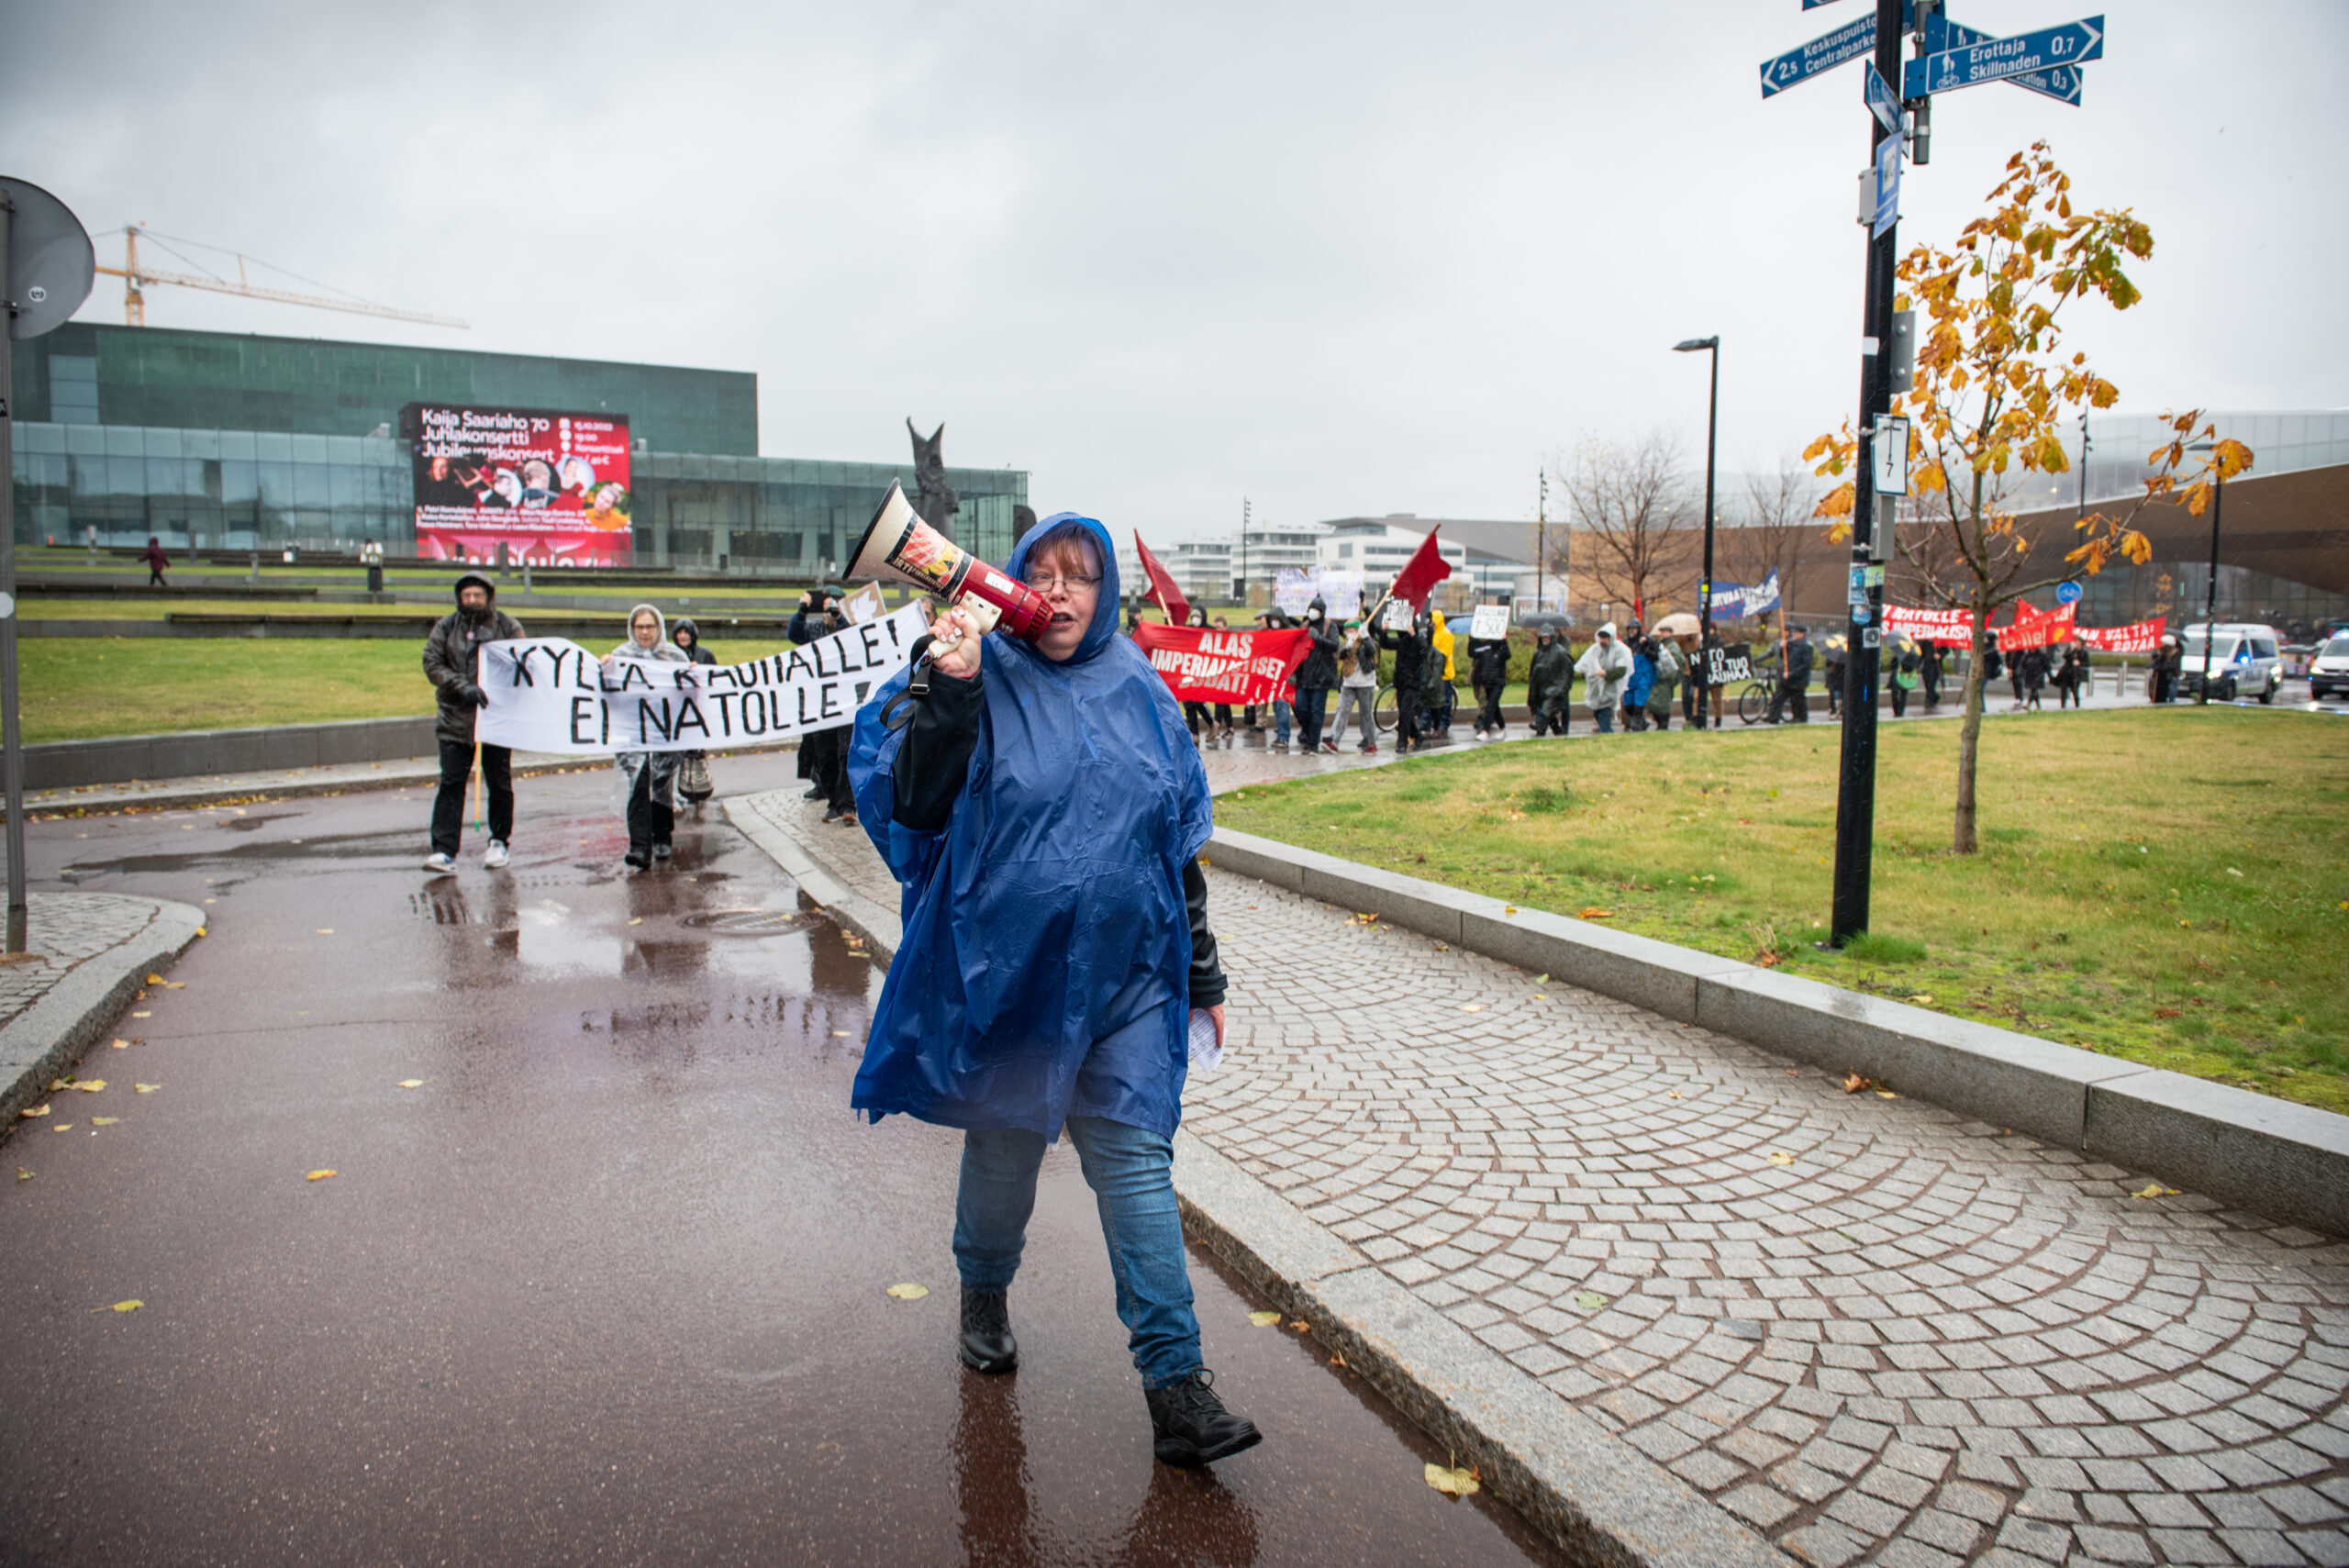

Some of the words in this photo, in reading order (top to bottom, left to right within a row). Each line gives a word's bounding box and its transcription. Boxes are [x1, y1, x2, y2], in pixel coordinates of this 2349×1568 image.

[1803, 16, 1877, 60] Keskuspuisto
[1969, 39, 2026, 63] Erottaja
[2051, 35, 2076, 55] 0,7
[1805, 32, 1876, 73] Centralparke
[1778, 61, 1799, 81] 2,5
[1969, 54, 2042, 81] Skillnaden
[2052, 69, 2068, 90] 0,3
[421, 409, 460, 428] Kaija
[462, 410, 529, 430] Saariaho
[529, 417, 551, 432] 70
[421, 426, 530, 446] Juhlakonsertti
[1892, 621, 1973, 641] IMPERIALISM
[1197, 631, 1253, 660] ALAS
[1689, 647, 1725, 667] NTO
[508, 645, 655, 693] KYLLÄ
[1708, 668, 1753, 684] AUHAA
[571, 696, 609, 745] EI
